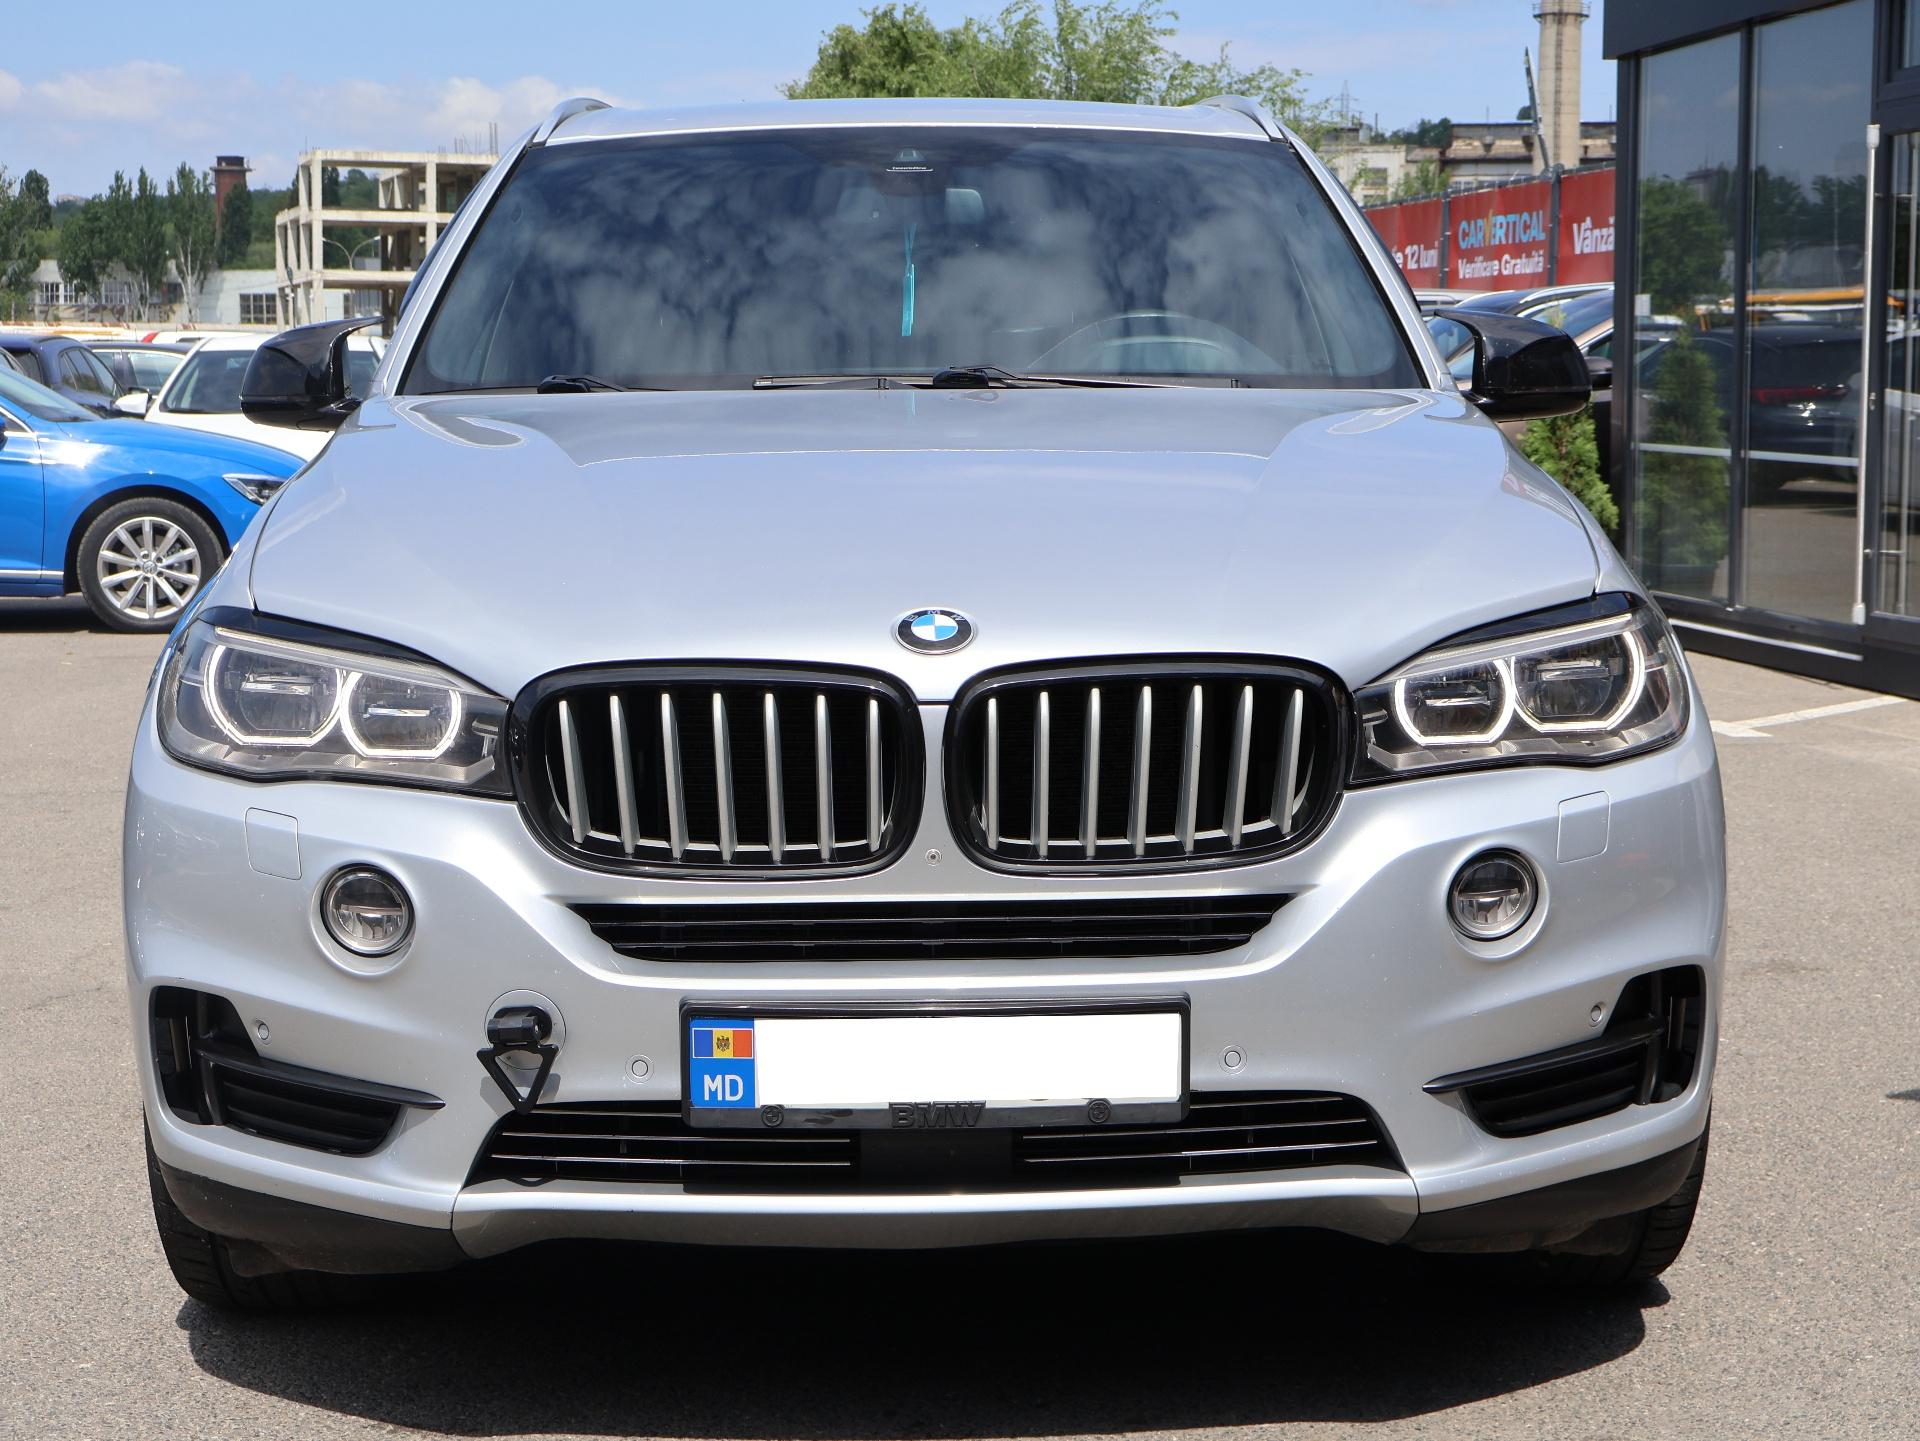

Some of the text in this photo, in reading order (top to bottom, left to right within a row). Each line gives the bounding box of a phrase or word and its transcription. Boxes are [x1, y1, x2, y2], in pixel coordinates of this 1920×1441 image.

[1458, 209, 1546, 250] CARVERTICAL
[1404, 244, 1418, 269] 12
[1420, 241, 1438, 268] luni
[1458, 249, 1544, 279] Verificare Gratuită
[703, 1074, 744, 1101] MD
[889, 1101, 986, 1128] BMW
